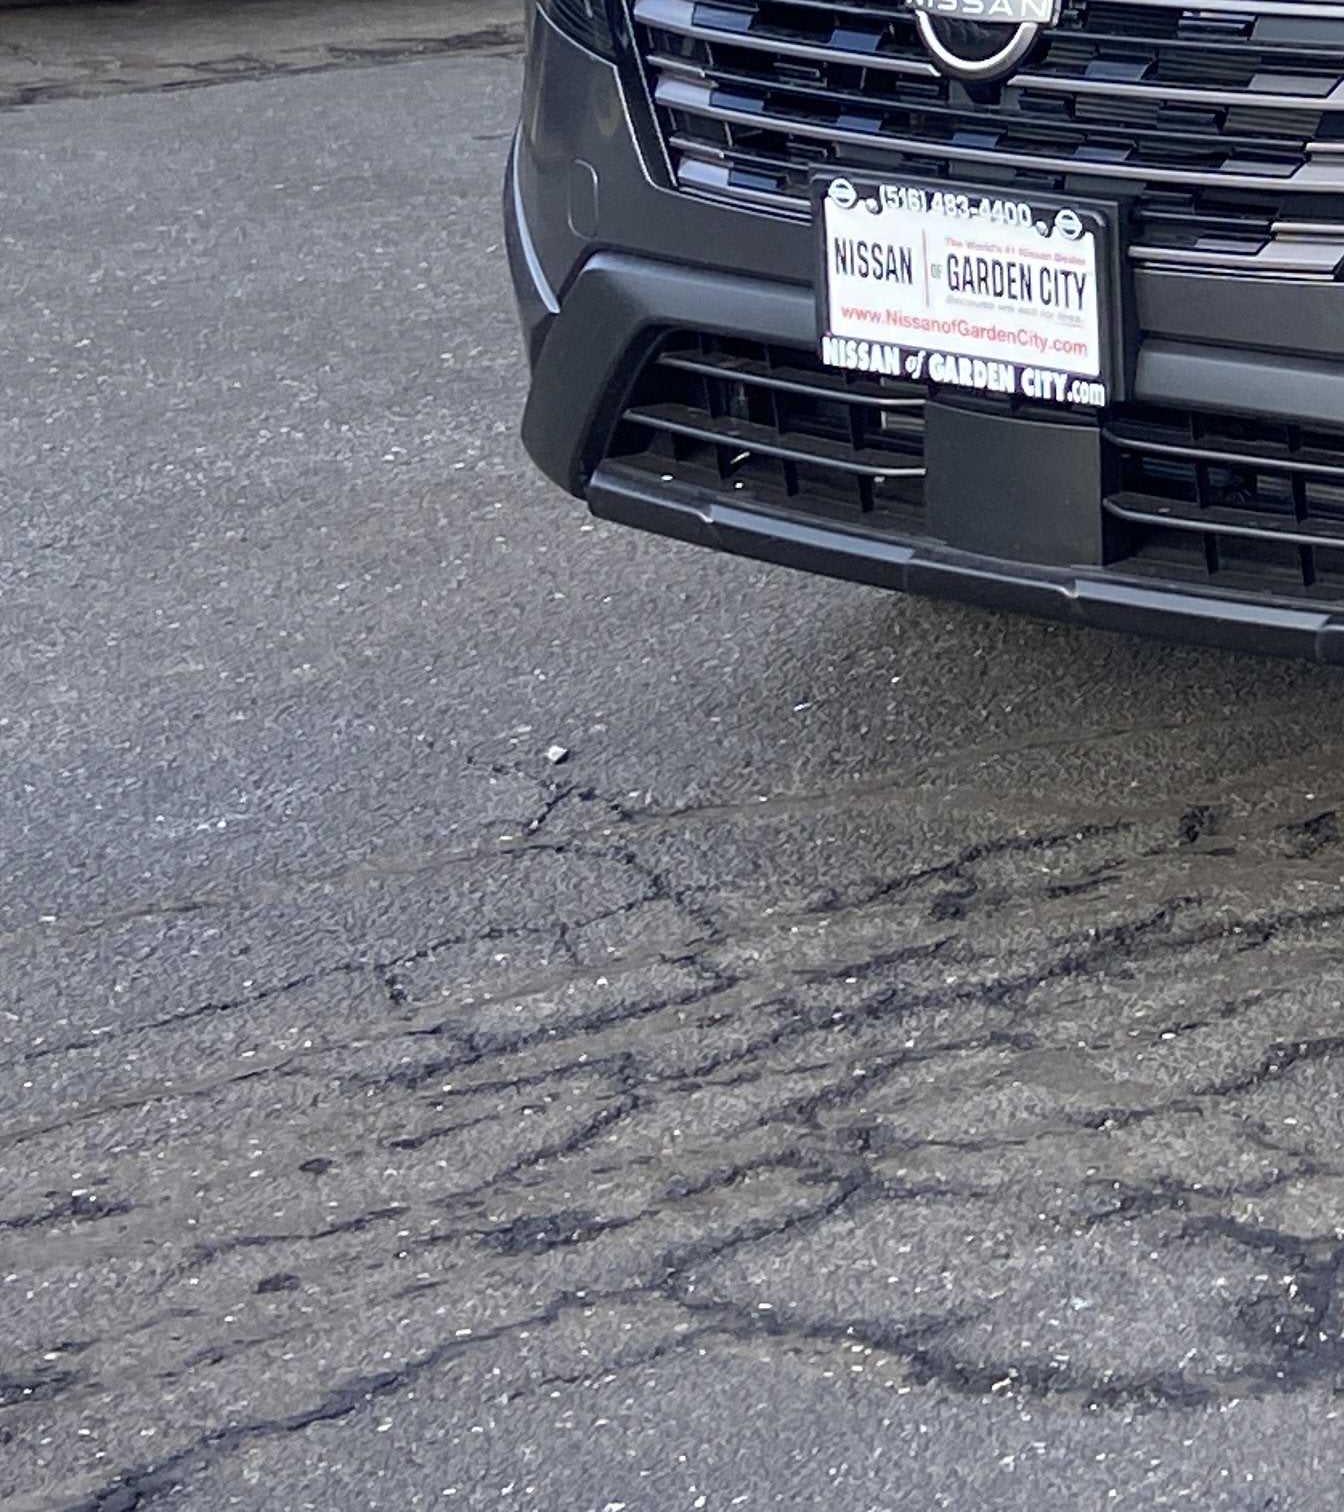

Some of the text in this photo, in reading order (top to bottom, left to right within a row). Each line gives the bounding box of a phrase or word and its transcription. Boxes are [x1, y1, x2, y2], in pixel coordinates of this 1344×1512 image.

[932, 192, 1033, 228] 483-4400
[834, 236, 913, 285] NISSAN
[947, 252, 1033, 303] GARDEN
[1039, 266, 1087, 311] CITY
[841, 305, 1088, 356] www.NissanofGardenCity.com
[822, 336, 899, 375] NISSAN
[904, 350, 925, 379] of
[928, 352, 1015, 393] GARDEN
